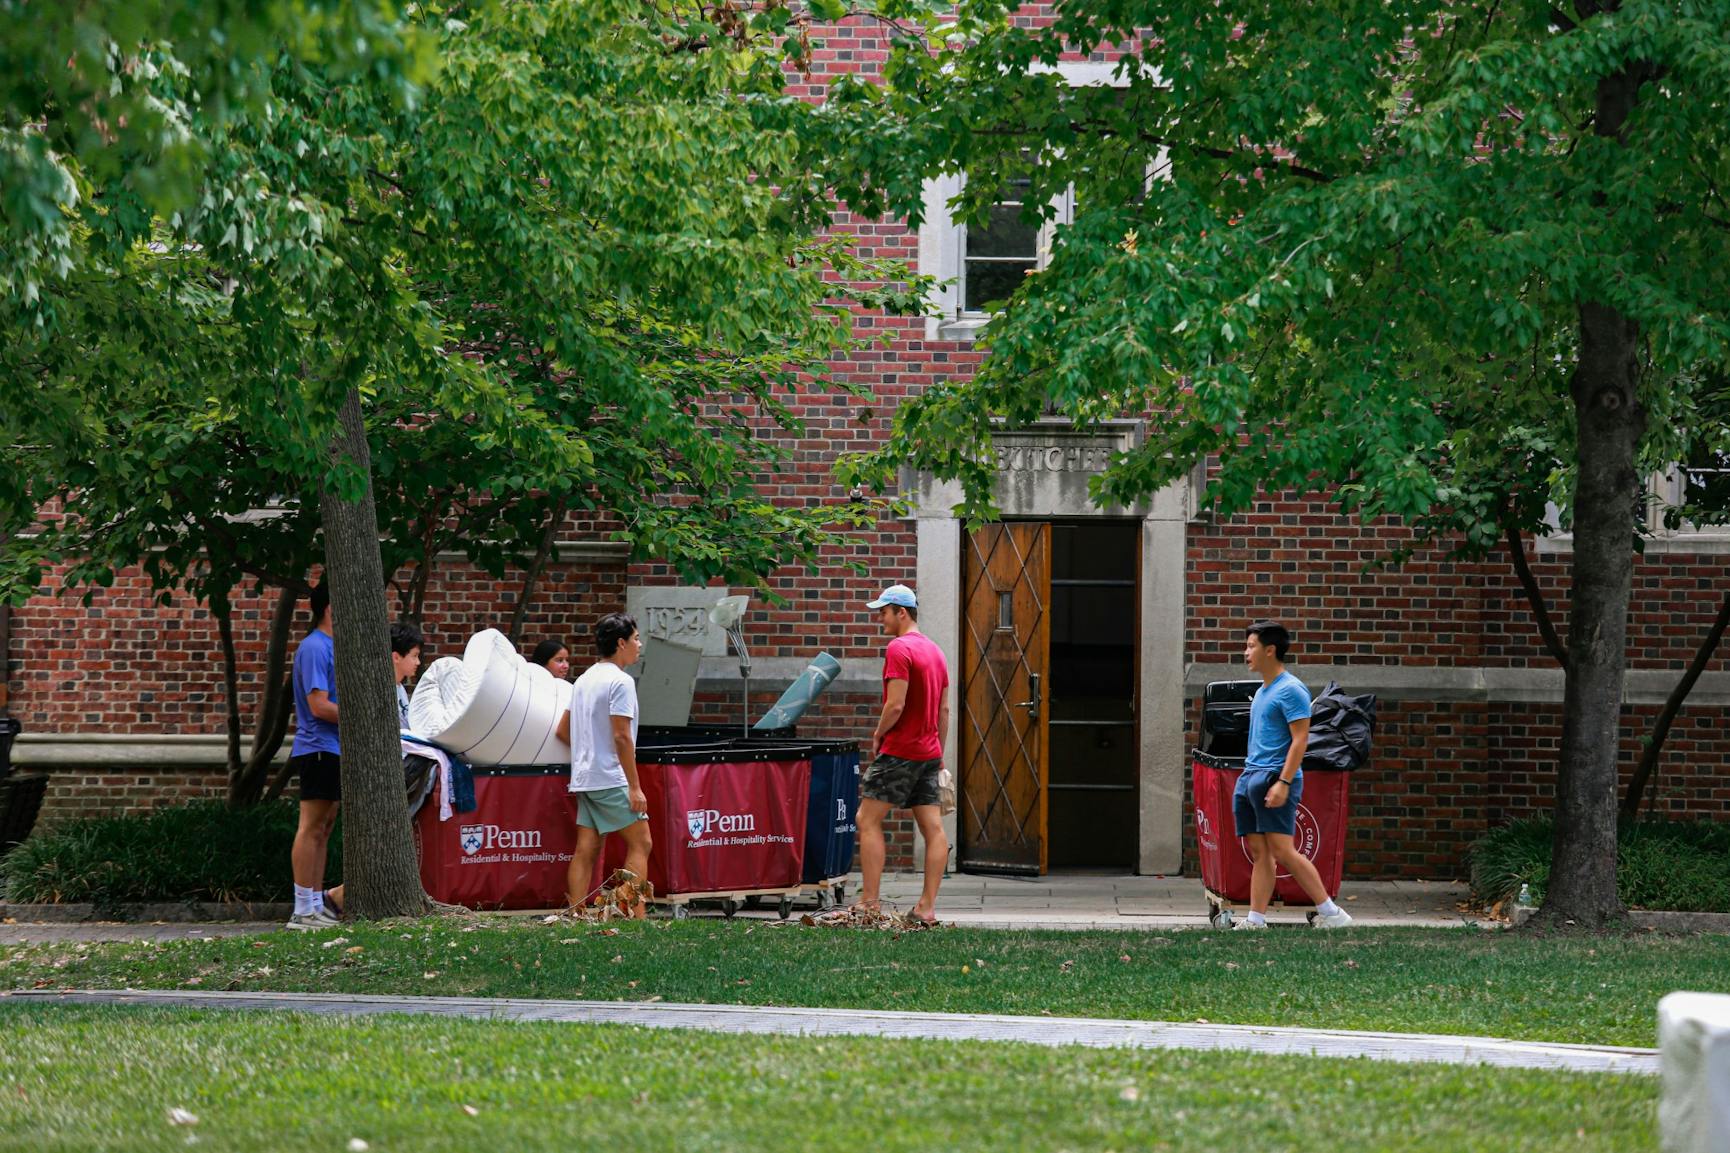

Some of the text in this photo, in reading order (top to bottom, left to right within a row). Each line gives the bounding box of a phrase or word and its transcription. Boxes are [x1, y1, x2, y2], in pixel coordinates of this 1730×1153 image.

[704, 809, 755, 833] Penn
[484, 824, 542, 849] Penn
[730, 835, 766, 847] Hospitality
[766, 834, 795, 844] Services
[1306, 827, 1314, 856] COMF
[502, 853, 509, 862] &
[512, 852, 556, 864] Hospitality
